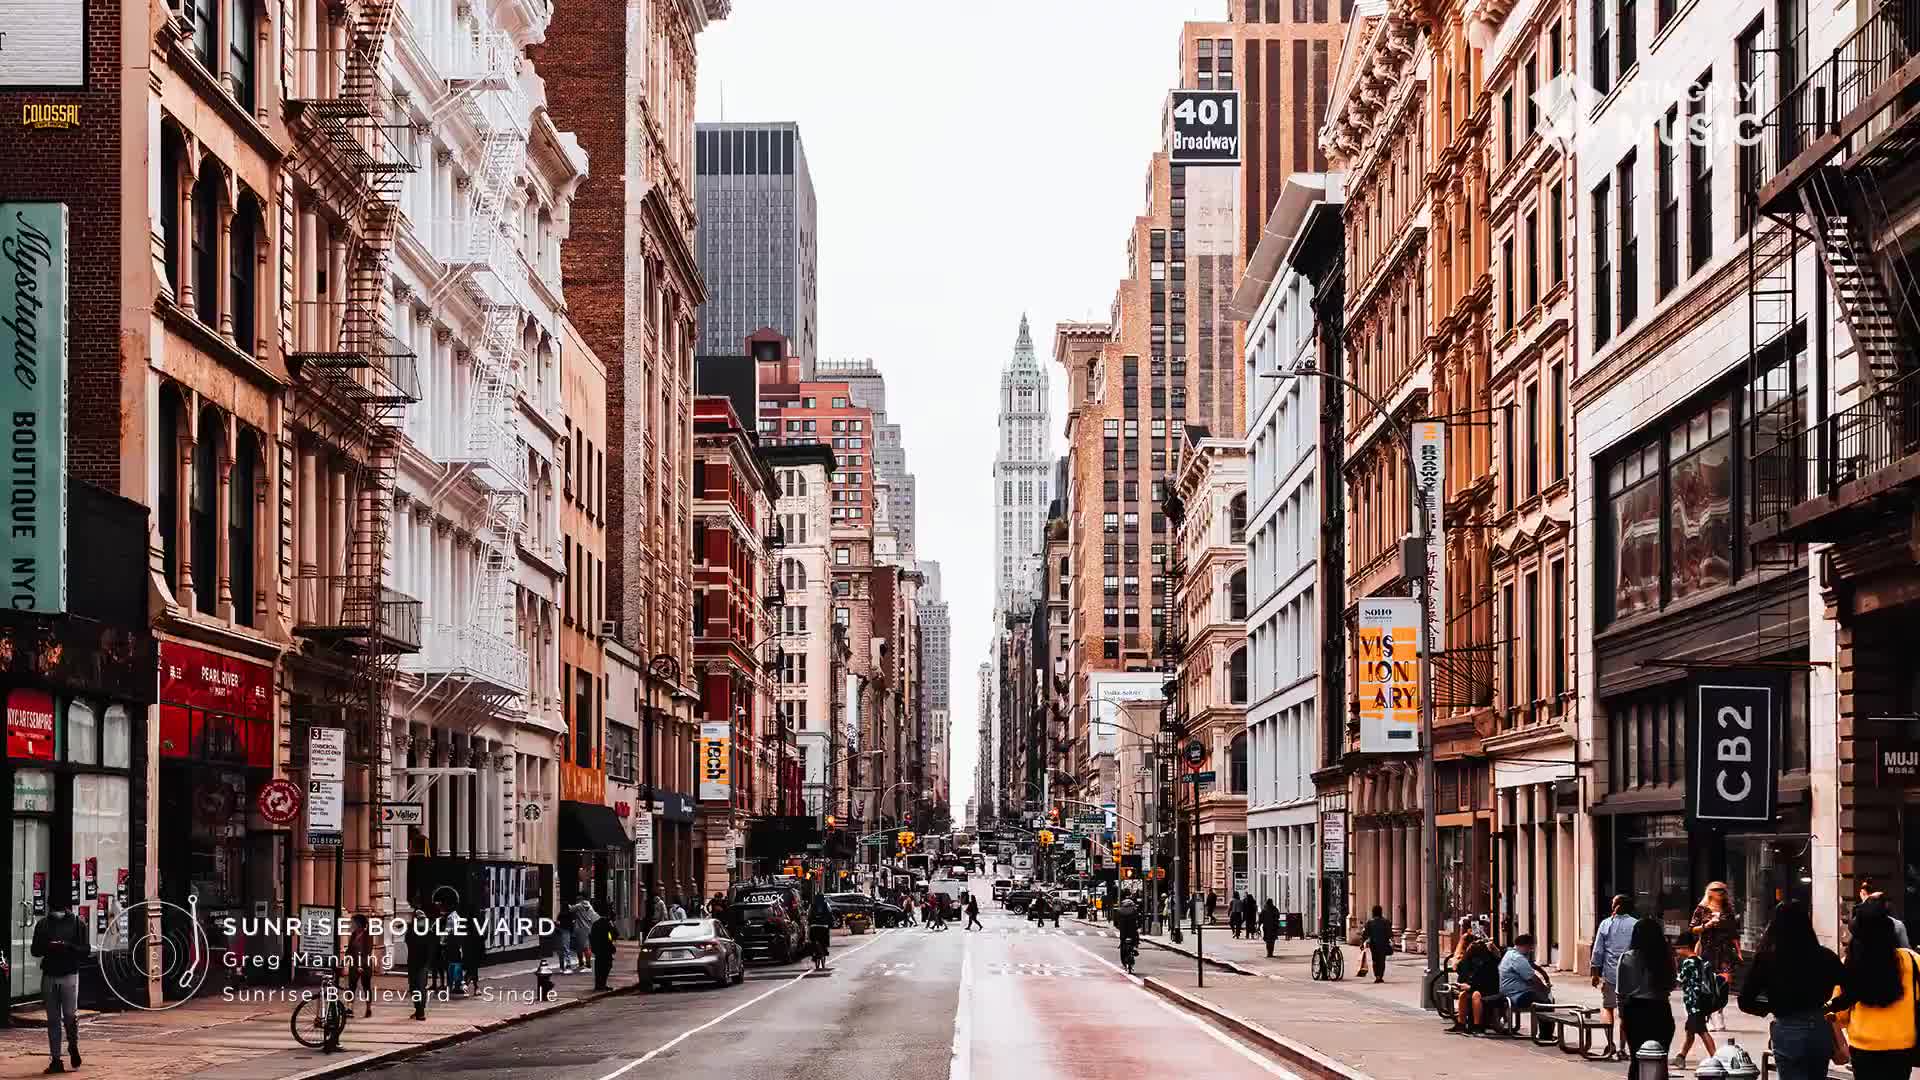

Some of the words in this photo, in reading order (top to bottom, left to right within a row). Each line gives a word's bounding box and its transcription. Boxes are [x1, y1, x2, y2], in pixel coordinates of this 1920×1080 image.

[23, 103, 81, 126] COLOSSAL
[1174, 98, 1233, 125] 401
[1173, 131, 1238, 155] Broadway
[2, 210, 52, 392] Mystique
[10, 411, 37, 539] BOUTIQUE
[10, 557, 37, 610] NYC
[1365, 608, 1392, 616] SOHO
[1361, 634, 1395, 658] VIS
[201, 666, 221, 684] PEARL
[221, 671, 239, 687] RIVER
[1367, 660, 1410, 683] ION
[1372, 687, 1417, 709] ARY
[312, 729, 320, 739] 3
[1716, 705, 1752, 802] CB2
[1884, 752, 1919, 766] MUJI
[312, 782, 318, 792] 2
[396, 809, 419, 821] Valley
